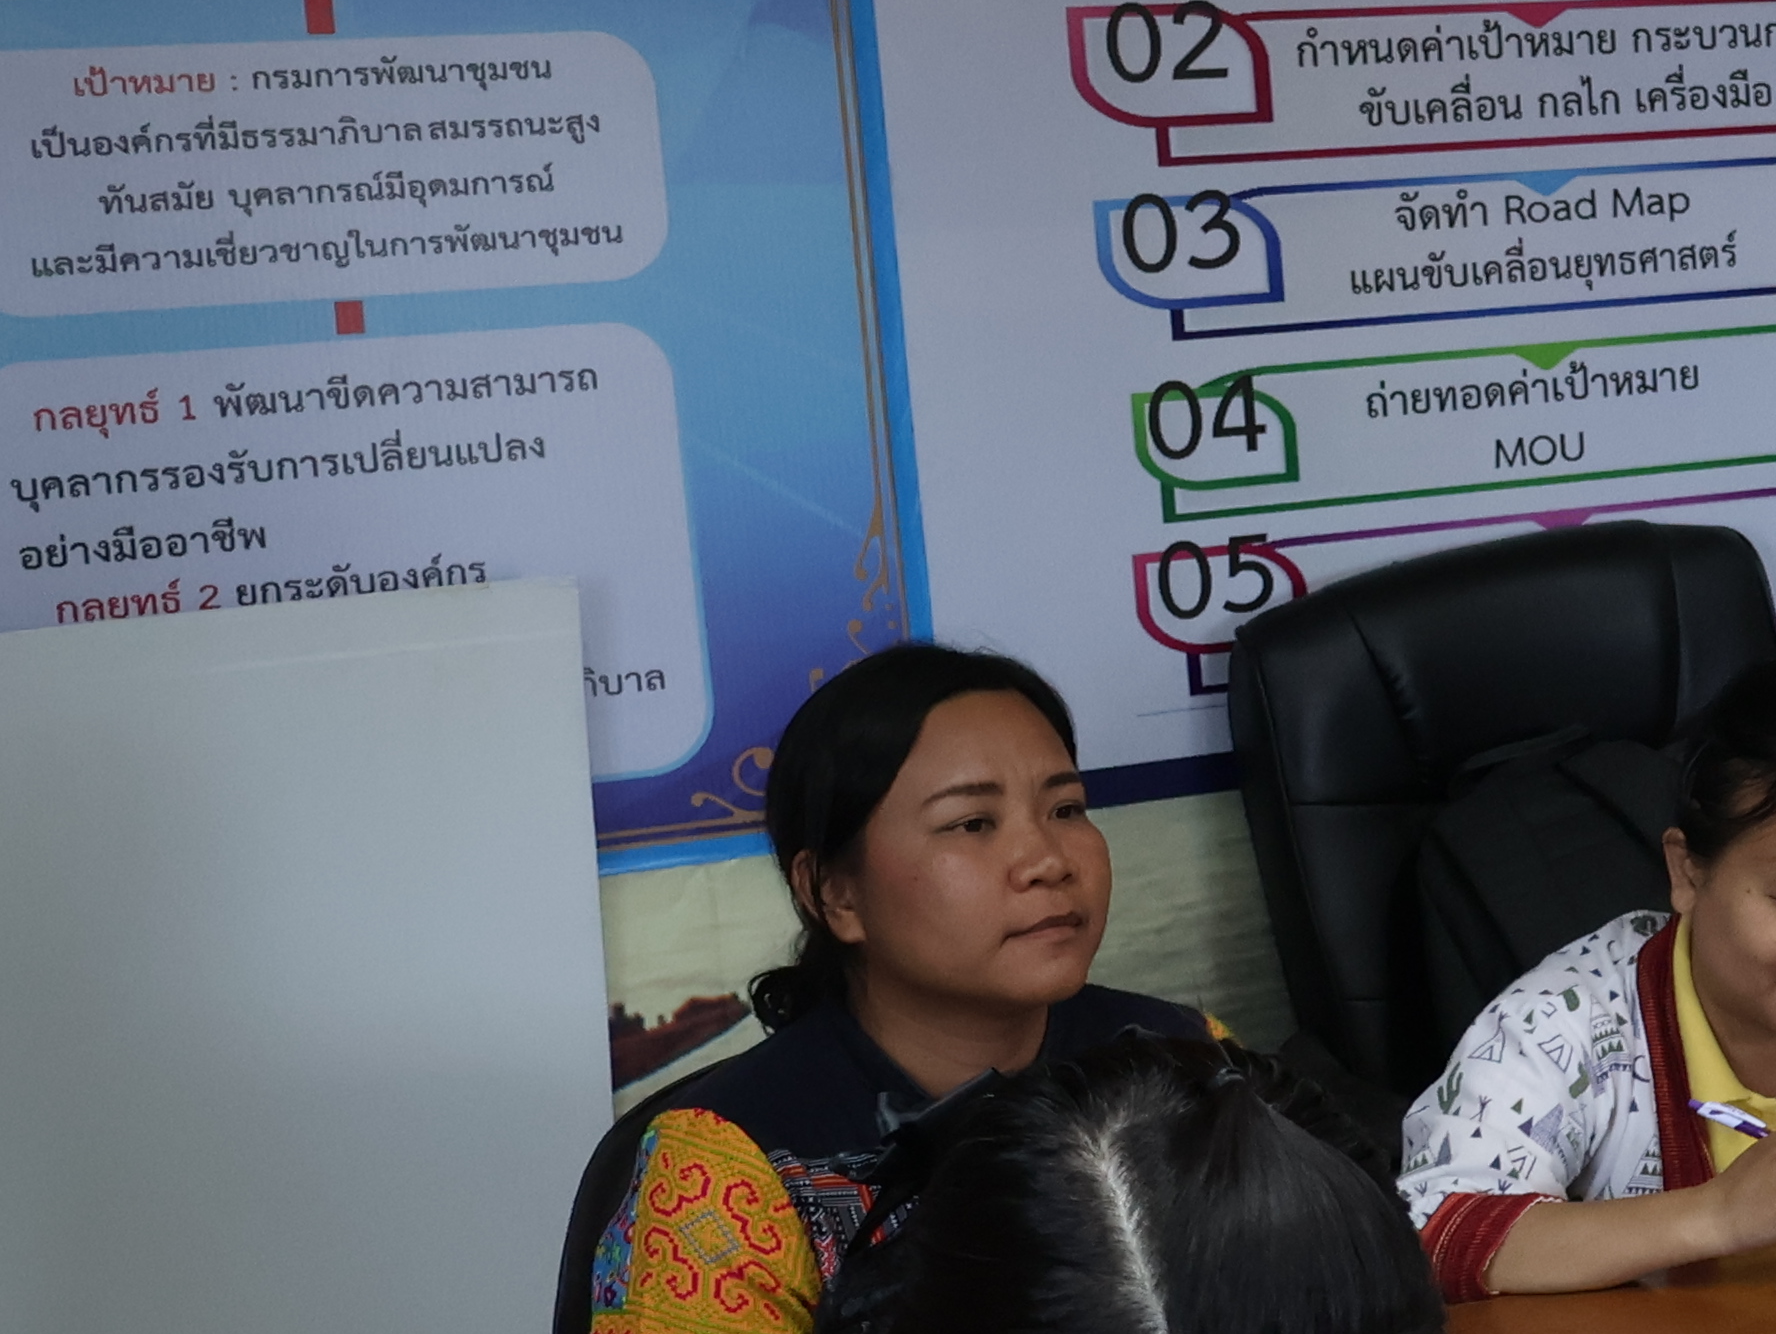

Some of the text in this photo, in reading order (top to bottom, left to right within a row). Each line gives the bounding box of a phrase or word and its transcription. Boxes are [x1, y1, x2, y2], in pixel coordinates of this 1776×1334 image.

[1105, 0, 1231, 85] 02
[1296, 22, 1615, 71] กำหนดค่าเป้าหมาย
[74, 65, 215, 100] เป้าหมาย
[252, 53, 552, 93] กรมการพัฒนาชุมชน
[1360, 72, 1773, 130] ขับเคลื่อน กลไก เครื่องมือ
[30, 111, 600, 161] เป็นองค์กรที่มีธรรมาภิบาล สมรรถนะสูง
[98, 184, 214, 217] ทันสมัย
[1395, 186, 1692, 232] จัดทำ Road Map
[30, 220, 624, 280] และมีความเชี่ยวชาญในการพัฒนาชุมชน
[1122, 189, 1243, 274] 03
[1350, 231, 1740, 297] แผนขับเคลื่อนยุทธศาสตร์
[33, 364, 599, 440] กลยุทธ์ 1 พัฒนาขีดความสามารถ
[1148, 376, 1268, 461] 04
[1365, 357, 1700, 420] ถ่ายทอดค่าเป้าหมาย
[10, 431, 547, 513] บุคลากรรองรับการเปลี่ยนแปลง
[1494, 431, 1587, 471] MOU
[55, 579, 181, 625] กลยทธ์
[199, 584, 220, 610] 2
[1156, 535, 1276, 620] 05
